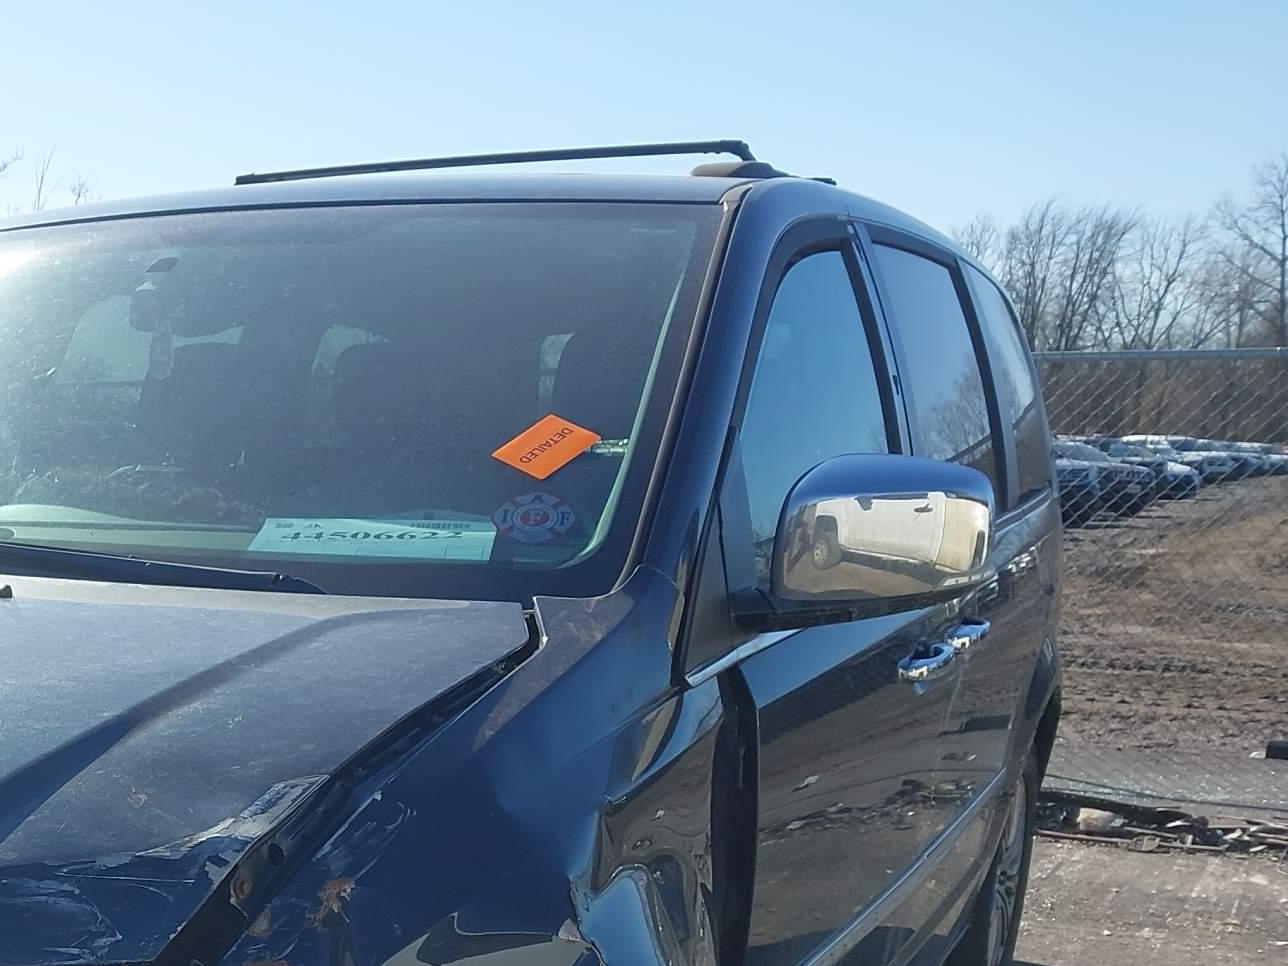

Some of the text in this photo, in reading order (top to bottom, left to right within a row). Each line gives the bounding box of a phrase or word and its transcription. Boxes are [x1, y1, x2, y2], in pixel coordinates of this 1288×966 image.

[519, 427, 574, 464] DETAILED
[559, 511, 572, 526] F
[280, 531, 463, 541] 44506622
